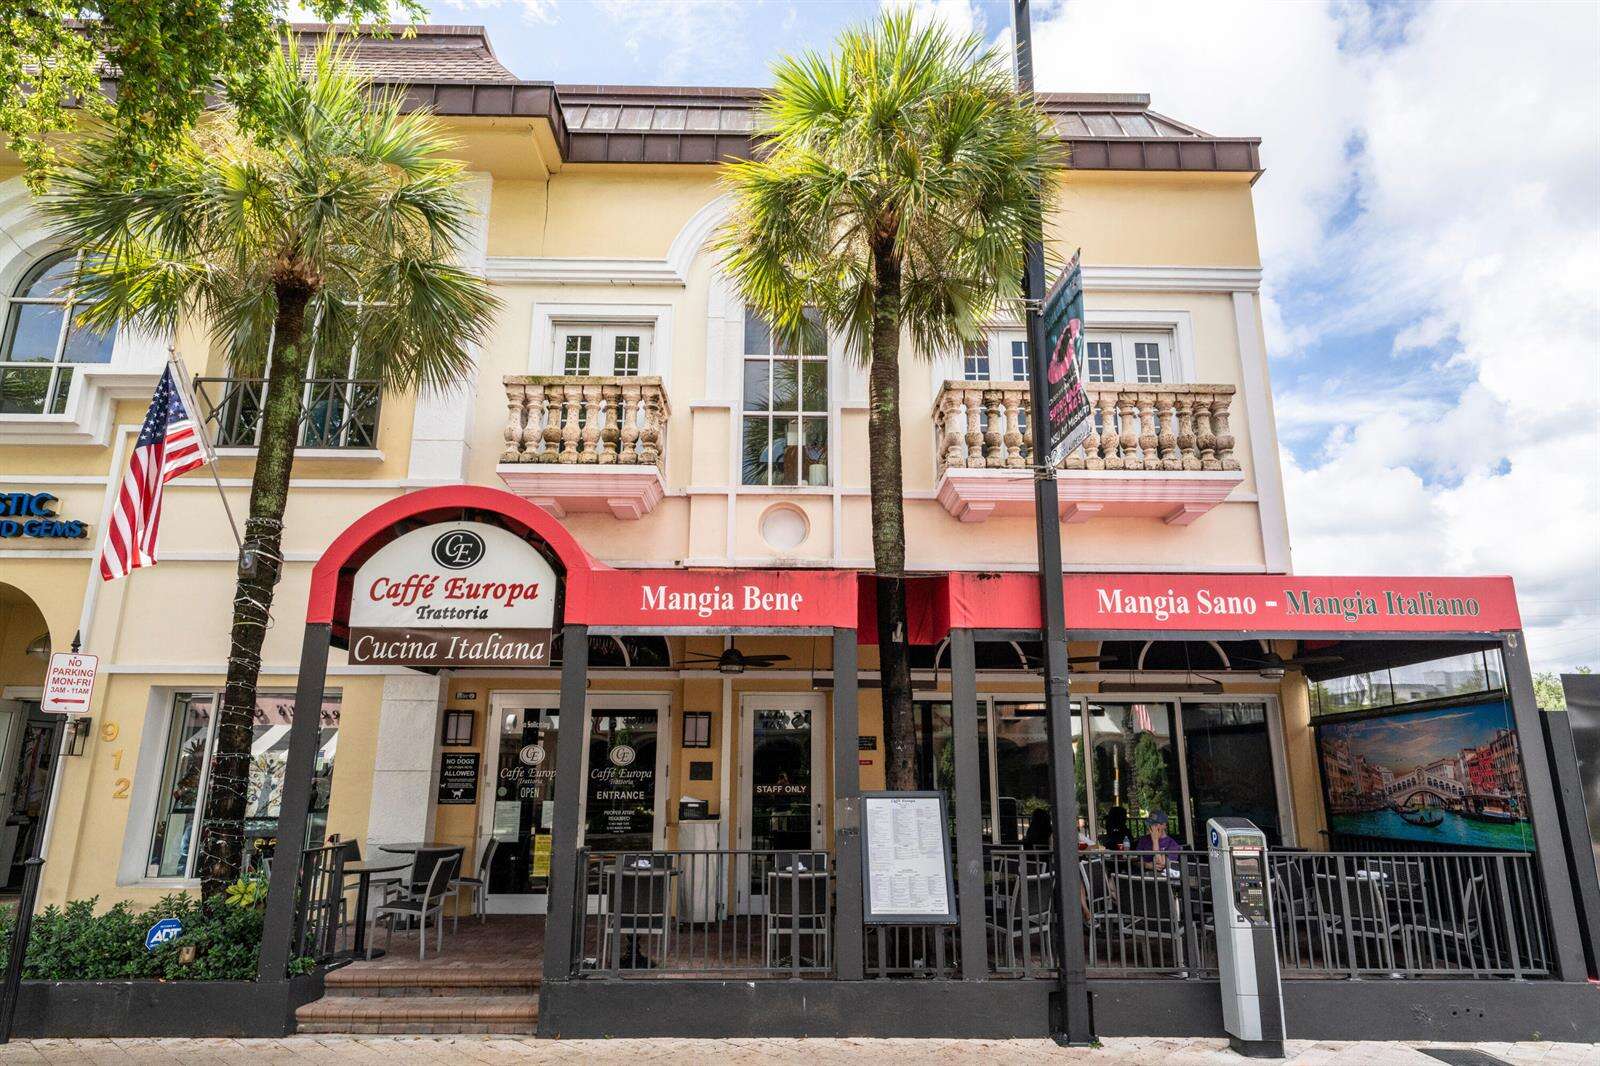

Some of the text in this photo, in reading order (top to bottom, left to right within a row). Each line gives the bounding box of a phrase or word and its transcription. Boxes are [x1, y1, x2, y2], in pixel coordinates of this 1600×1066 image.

[23, 520, 88, 539] GEMS
[369, 574, 539, 608] Caffé Europa
[640, 585, 803, 618] Mangia Bene
[1096, 588, 1190, 621] Mangia
[1197, 589, 1257, 615] Sano
[1283, 589, 1379, 623] Mangia
[1383, 590, 1480, 617] Italiano
[416, 604, 489, 620] Trattoria
[354, 632, 544, 662] Cucina Italiana
[68, 659, 82, 667] NO
[52, 667, 94, 677] PARKING
[51, 677, 91, 686] MON-FRI
[50, 686, 66, 694] 3AM
[101, 720, 131, 799] 912
[528, 767, 557, 781] Europ
[618, 768, 652, 781] Europa
[521, 787, 540, 798] OPEN
[597, 791, 645, 800] ENTRANCE
[757, 785, 807, 793] STAFF ONLY
[150, 928, 181, 943] ADT
